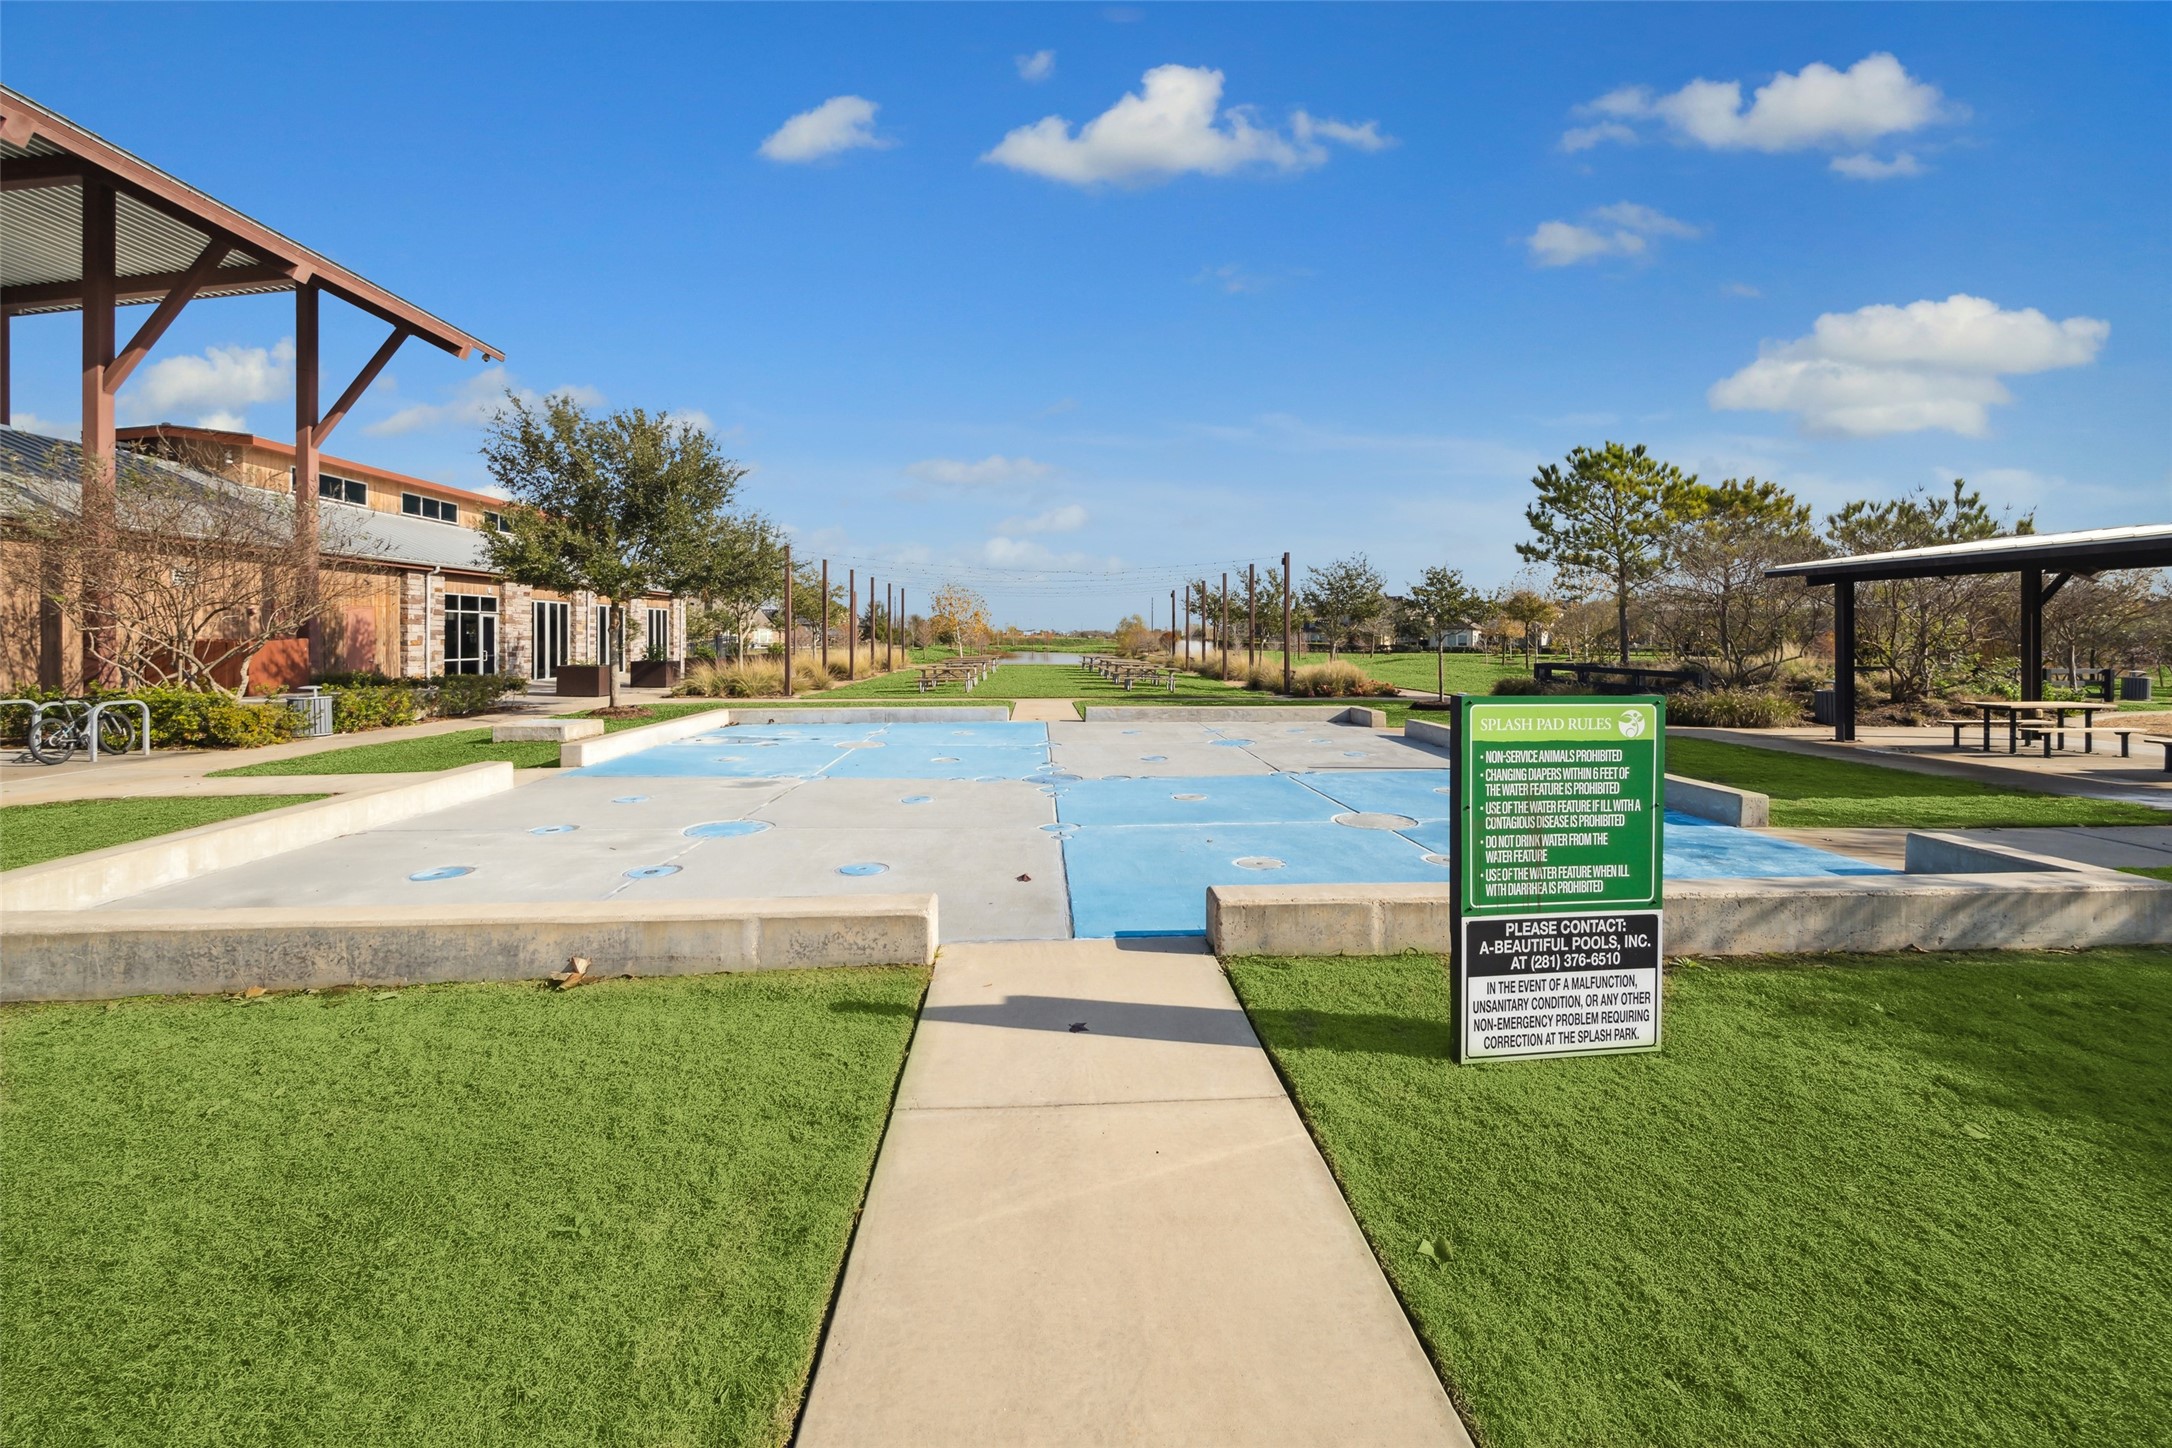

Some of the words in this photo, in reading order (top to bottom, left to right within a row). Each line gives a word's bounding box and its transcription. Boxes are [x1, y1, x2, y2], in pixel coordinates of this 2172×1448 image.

[1480, 718, 1532, 731] SPLASH
[1537, 718, 1564, 731] PAD
[1568, 718, 1611, 730] RULES
[1486, 750, 1538, 763] NON-SERVICE
[1539, 750, 1574, 762] ANIMALS
[1576, 749, 1622, 762] PROHIBITED
[1485, 768, 1526, 781] CHANGING
[1528, 768, 1561, 780] DIAPERS
[1563, 767, 1592, 780] WITHIN
[1593, 767, 1598, 779] 6
[1601, 767, 1618, 779] FEET
[1619, 767, 1630, 779] OF
[1485, 784, 1501, 796] THE
[1502, 783, 1529, 796] WATER
[1531, 782, 1563, 795] FEATURE
[1565, 782, 1572, 795] IS
[1574, 782, 1620, 794] PROHIBITED
[1485, 801, 1501, 814] USE
[1502, 801, 1513, 814] OF
[1514, 801, 1529, 814] THE
[1529, 801, 1556, 813] WATER
[1558, 800, 1591, 813] FEATURE
[1592, 800, 1600, 812] IF
[1600, 800, 1612, 812] ILL
[1613, 799, 1634, 812] WITH
[1635, 799, 1641, 811] A
[1485, 816, 1535, 829] CONTAGIOUS
[1537, 815, 1569, 828] DISEASE
[1570, 815, 1578, 828] IS
[1579, 814, 1625, 827] PROHIBITED
[1486, 836, 1497, 848] DO
[1499, 835, 1515, 848] NOT
[1516, 834, 1541, 847] DRINK
[1541, 834, 1568, 847] WATER
[1569, 834, 1591, 846] FROM
[1593, 833, 1608, 845] THE
[1486, 850, 1512, 863] WATER
[1514, 849, 1548, 862] FEATURE
[1486, 868, 1501, 882] USE
[1502, 868, 1513, 881] OF
[1514, 868, 1528, 880] THE
[1529, 867, 1556, 880] WATER
[1558, 866, 1592, 879] FEATURE
[1593, 865, 1617, 878] WHEN
[1618, 865, 1630, 877] ILL
[1486, 883, 1506, 896] WITH
[1508, 882, 1548, 896] DIARRHEA
[1548, 881, 1556, 894] IS
[1557, 880, 1603, 894] PROHIBITED
[1506, 921, 1557, 936] PLEASE
[1561, 919, 1626, 934] CONTACT:
[1479, 938, 1568, 955] A-BEAUTIFUL
[1572, 936, 1620, 951] POOLS,
[1625, 934, 1651, 948] INC.
[1511, 957, 1527, 970] AT
[1531, 954, 1560, 971] (281)
[1564, 952, 1620, 968] 376-6510
[1487, 982, 1496, 994] IN
[1498, 981, 1516, 994] THE
[1518, 979, 1546, 993] EVENT
[1549, 978, 1560, 991] OF
[1563, 978, 1570, 990] A
[1572, 975, 1637, 990] MALFUNCTION,
[1473, 998, 1529, 1013] UNSANITARY
[1531, 996, 1583, 1010] CONDITION,
[1586, 995, 1598, 1007] OR
[1600, 994, 1619, 1006] ANY
[1621, 992, 1651, 1005] OTHER
[1473, 1015, 1553, 1032] NON-EMERGENCY
[1556, 1012, 1598, 1026] PROBLEM
[1601, 1010, 1649, 1025] REQUIRING
[1484, 1034, 1543, 1049] CORRECTION
[1545, 1033, 1556, 1045] AT
[1558, 1032, 1575, 1044] THE
[1577, 1029, 1611, 1043] SPLASH
[1614, 1027, 1639, 1041] PARK.
